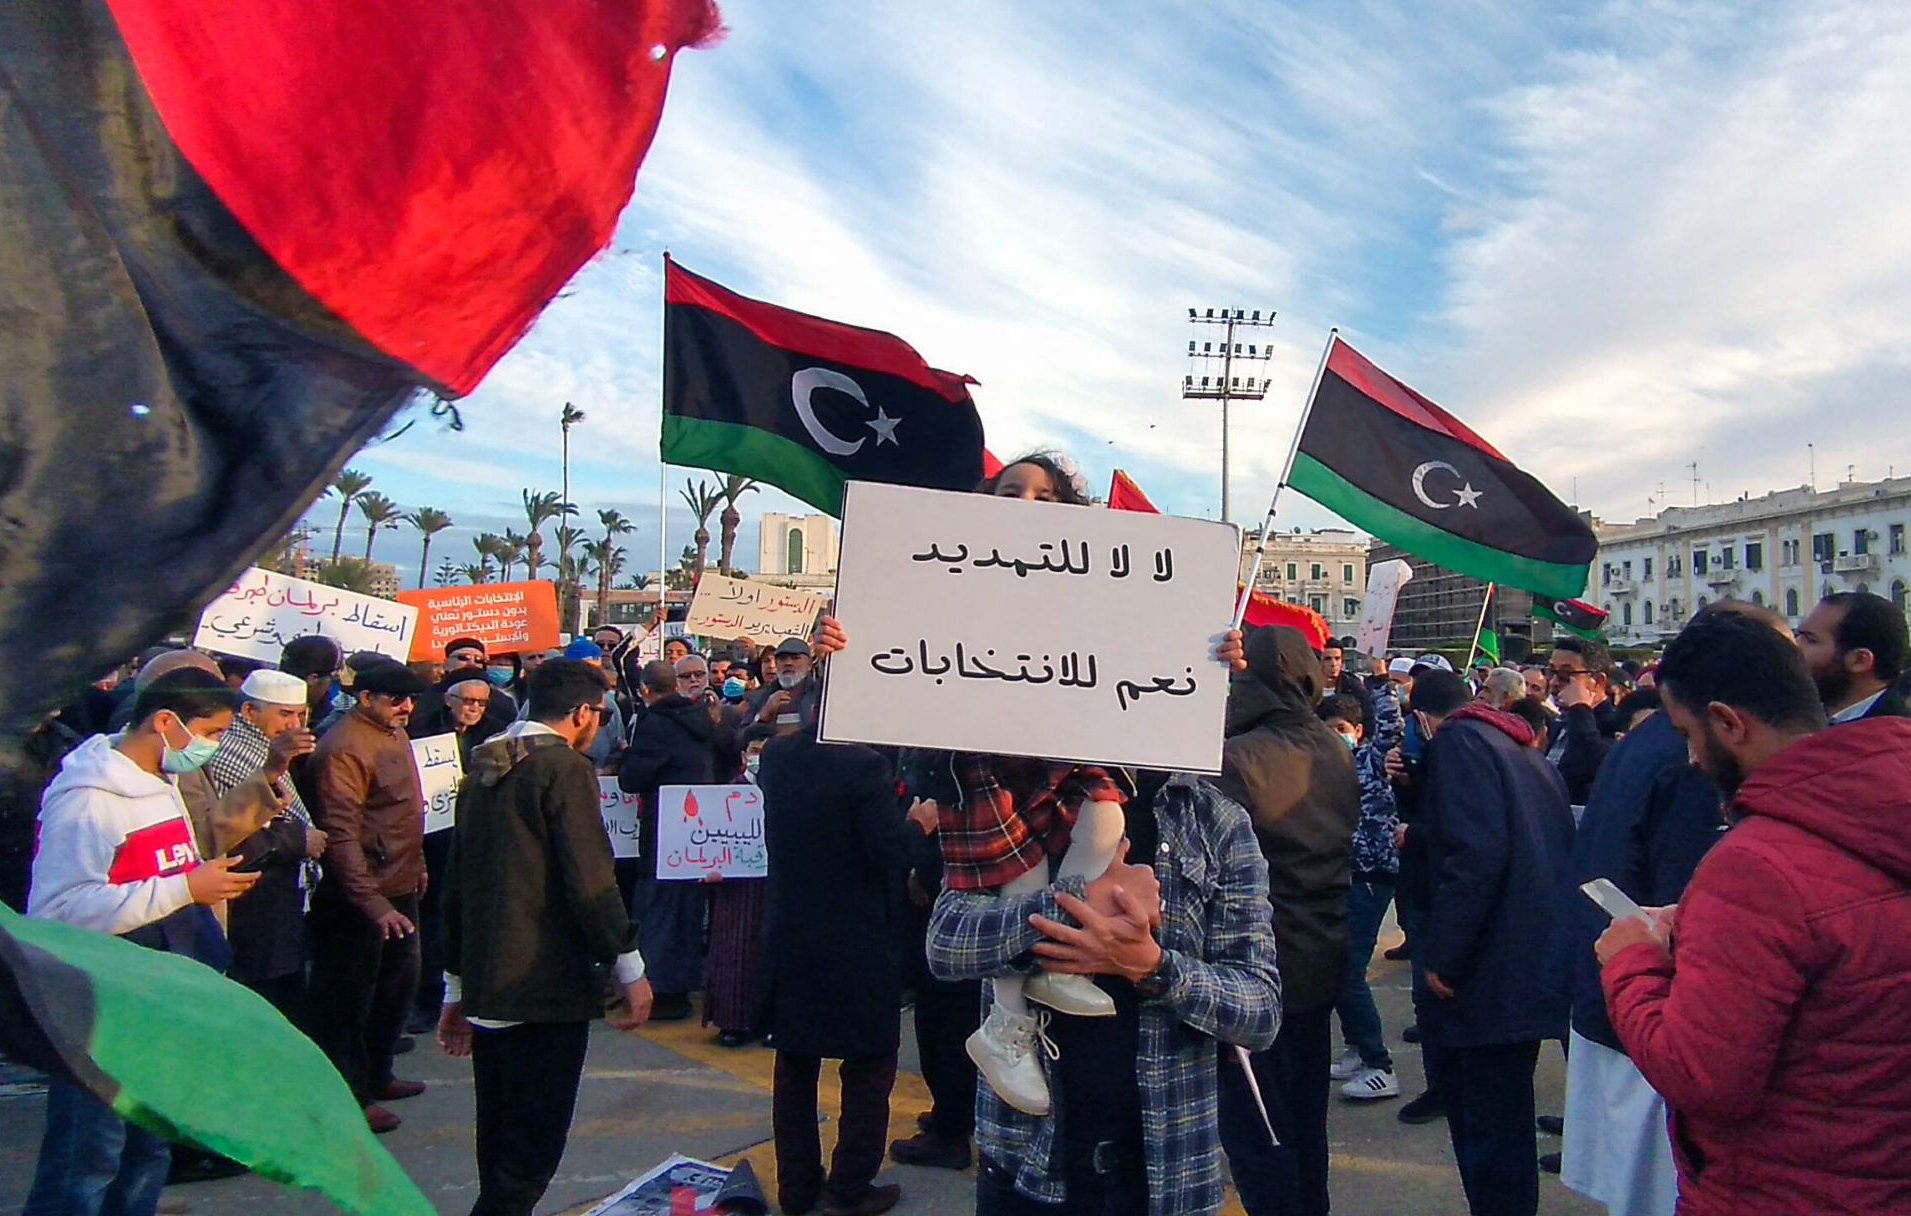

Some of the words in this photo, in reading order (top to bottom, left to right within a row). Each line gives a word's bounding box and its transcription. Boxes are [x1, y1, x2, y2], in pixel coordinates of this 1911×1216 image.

[912, 538, 1089, 577] للتمديد
[1109, 543, 1129, 579] لا
[1152, 547, 1173, 582] لا
[267, 587, 339, 615] برلمان
[428, 596, 472, 609] الرئاسية
[502, 606, 528, 617] بدون
[758, 595, 816, 614] الدستور
[342, 602, 407, 641] اسقاط
[430, 611, 460, 624] تعني
[744, 621, 770, 636] يريد
[771, 622, 810, 642] الشعب
[870, 639, 1098, 688] للانتخابات
[1115, 665, 1197, 711] نعم
[725, 791, 758, 822] دم
[667, 846, 733, 869] البرلمان
